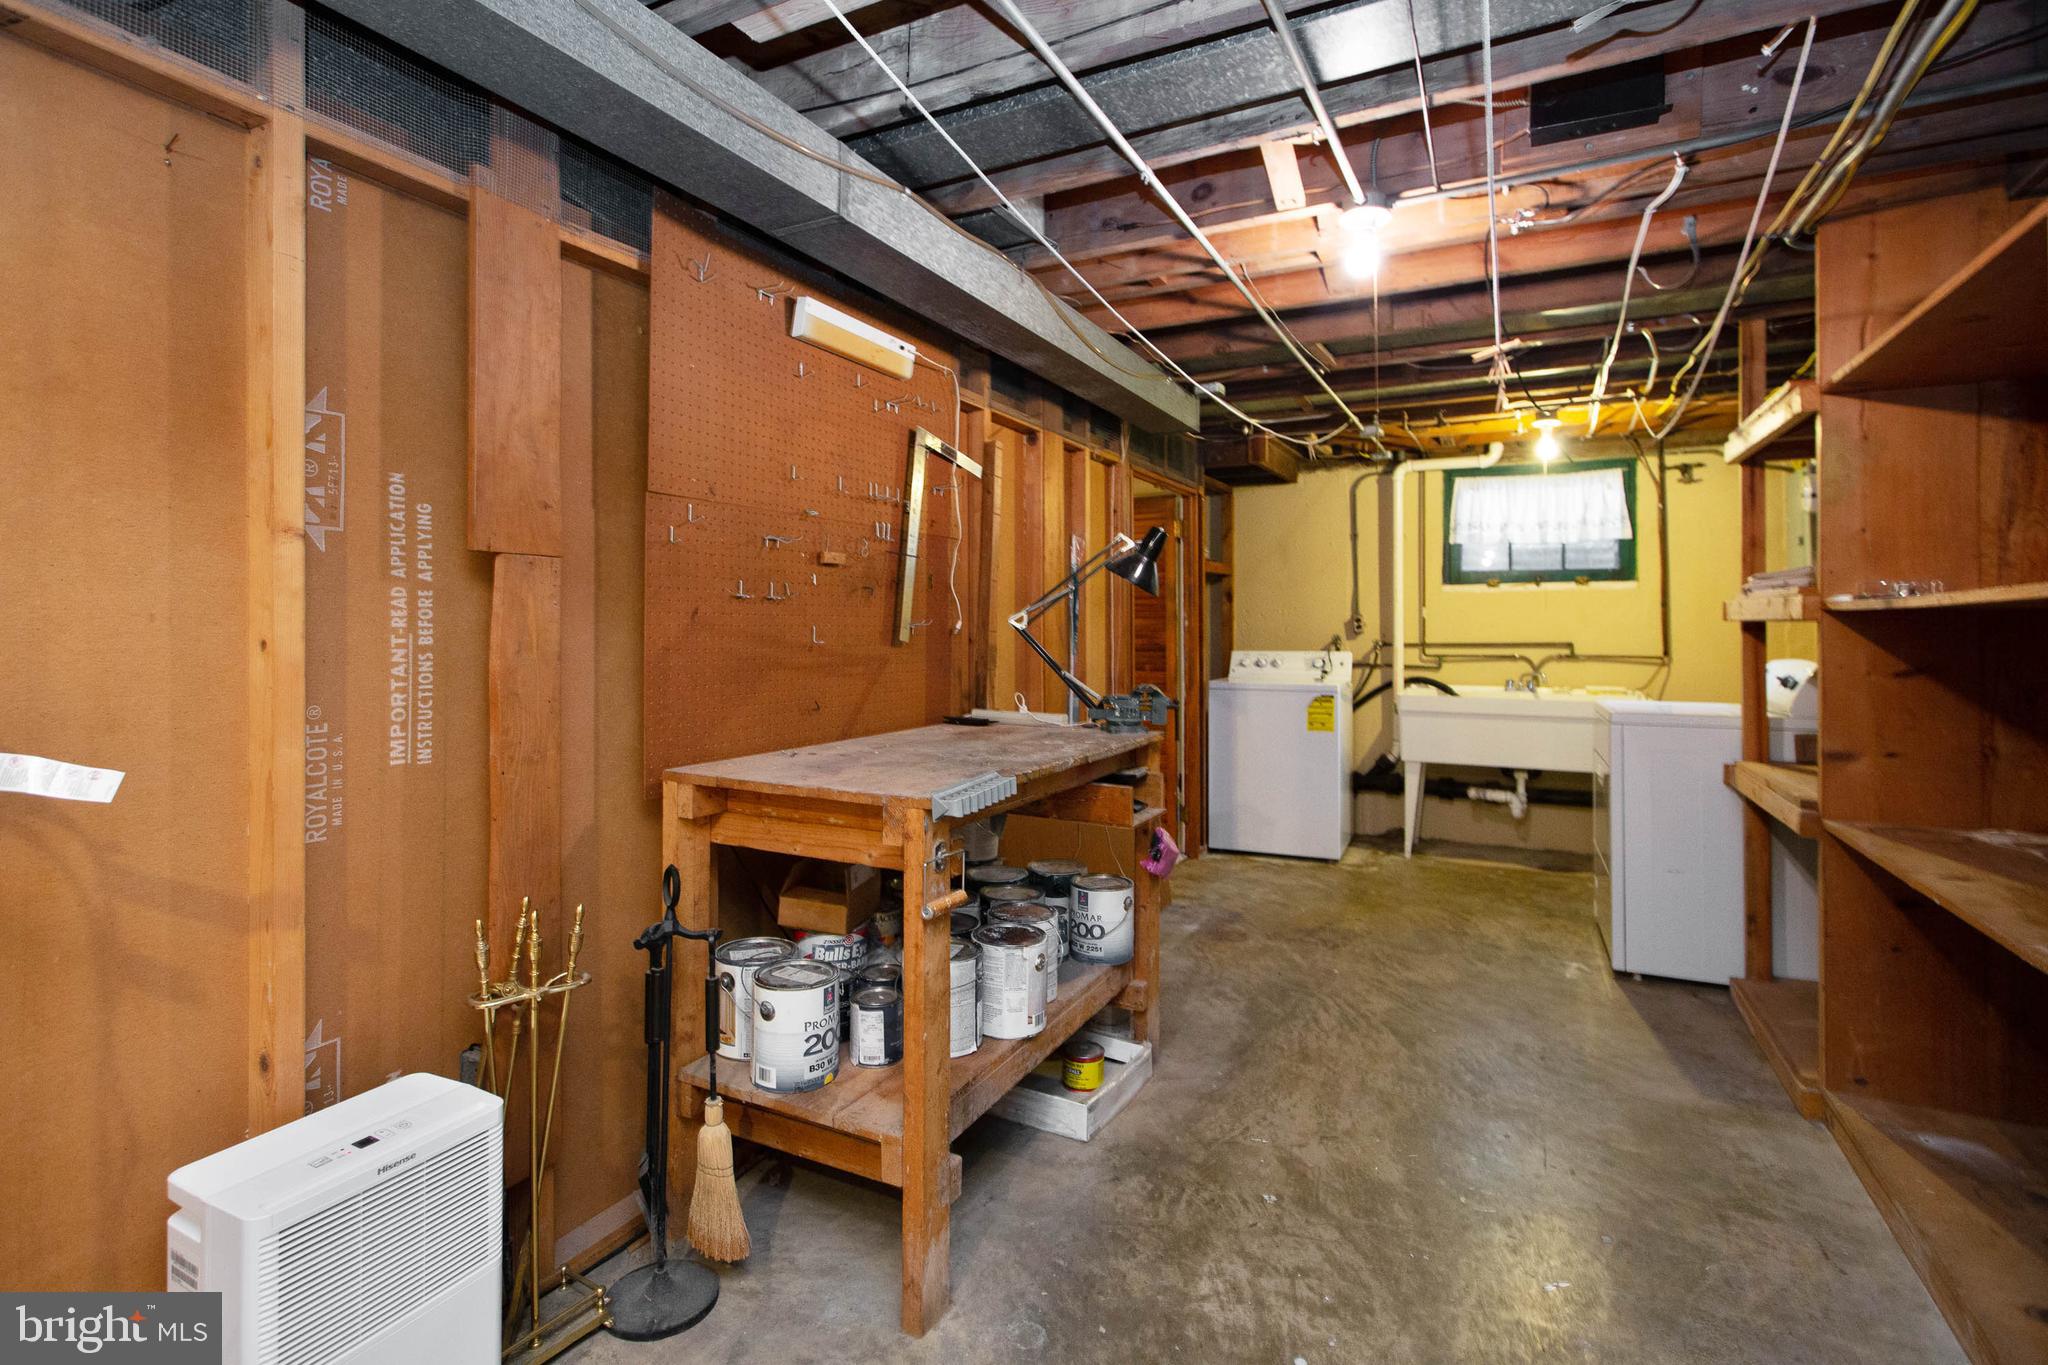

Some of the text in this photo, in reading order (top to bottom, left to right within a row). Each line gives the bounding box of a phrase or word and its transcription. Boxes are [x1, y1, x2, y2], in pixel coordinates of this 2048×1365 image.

[337, 174, 349, 206] MADE
[388, 471, 407, 579] APPLICATION
[416, 503, 434, 765] INSTRUCTIONS BEFORE APPLYING
[333, 778, 343, 789] IN
[332, 797, 343, 827] MADE
[1069, 918, 1106, 940] 200
[814, 946, 851, 962] Bulls
[809, 1060, 826, 1073] B30
[377, 1153, 417, 1176] Hisense
